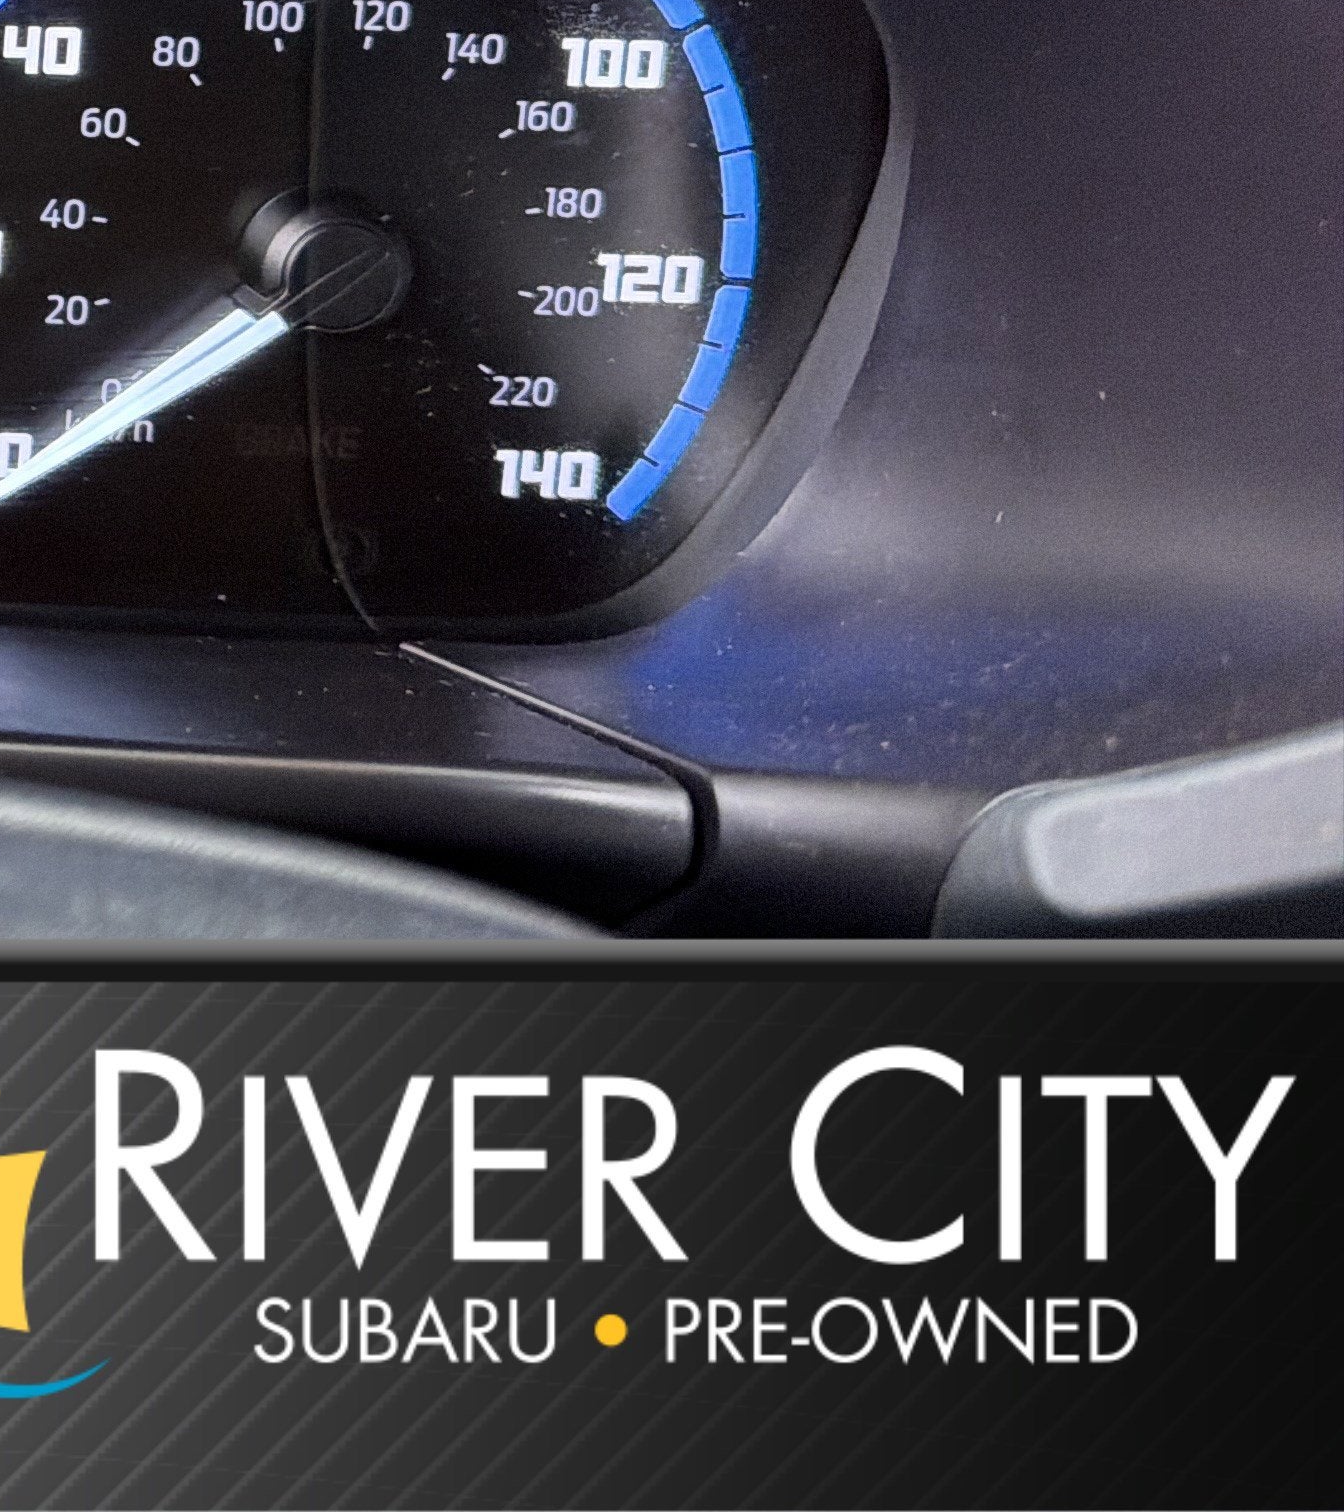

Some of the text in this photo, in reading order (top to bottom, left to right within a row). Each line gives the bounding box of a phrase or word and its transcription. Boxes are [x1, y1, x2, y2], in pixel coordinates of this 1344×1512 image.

[243, 1, 304, 32] 100
[354, 0, 410, 31] 120
[3, 26, 82, 75] 40
[153, 36, 199, 67] 80
[447, 33, 504, 64] 140
[562, 38, 668, 89] 100
[80, 108, 127, 139] 60
[517, 101, 575, 132] 160
[40, 199, 85, 229] 40
[546, 187, 604, 218] 180
[598, 253, 705, 304] 120
[45, 295, 88, 325] 20
[534, 285, 599, 319] 200
[489, 375, 556, 408] 220
[496, 450, 599, 500] 140
